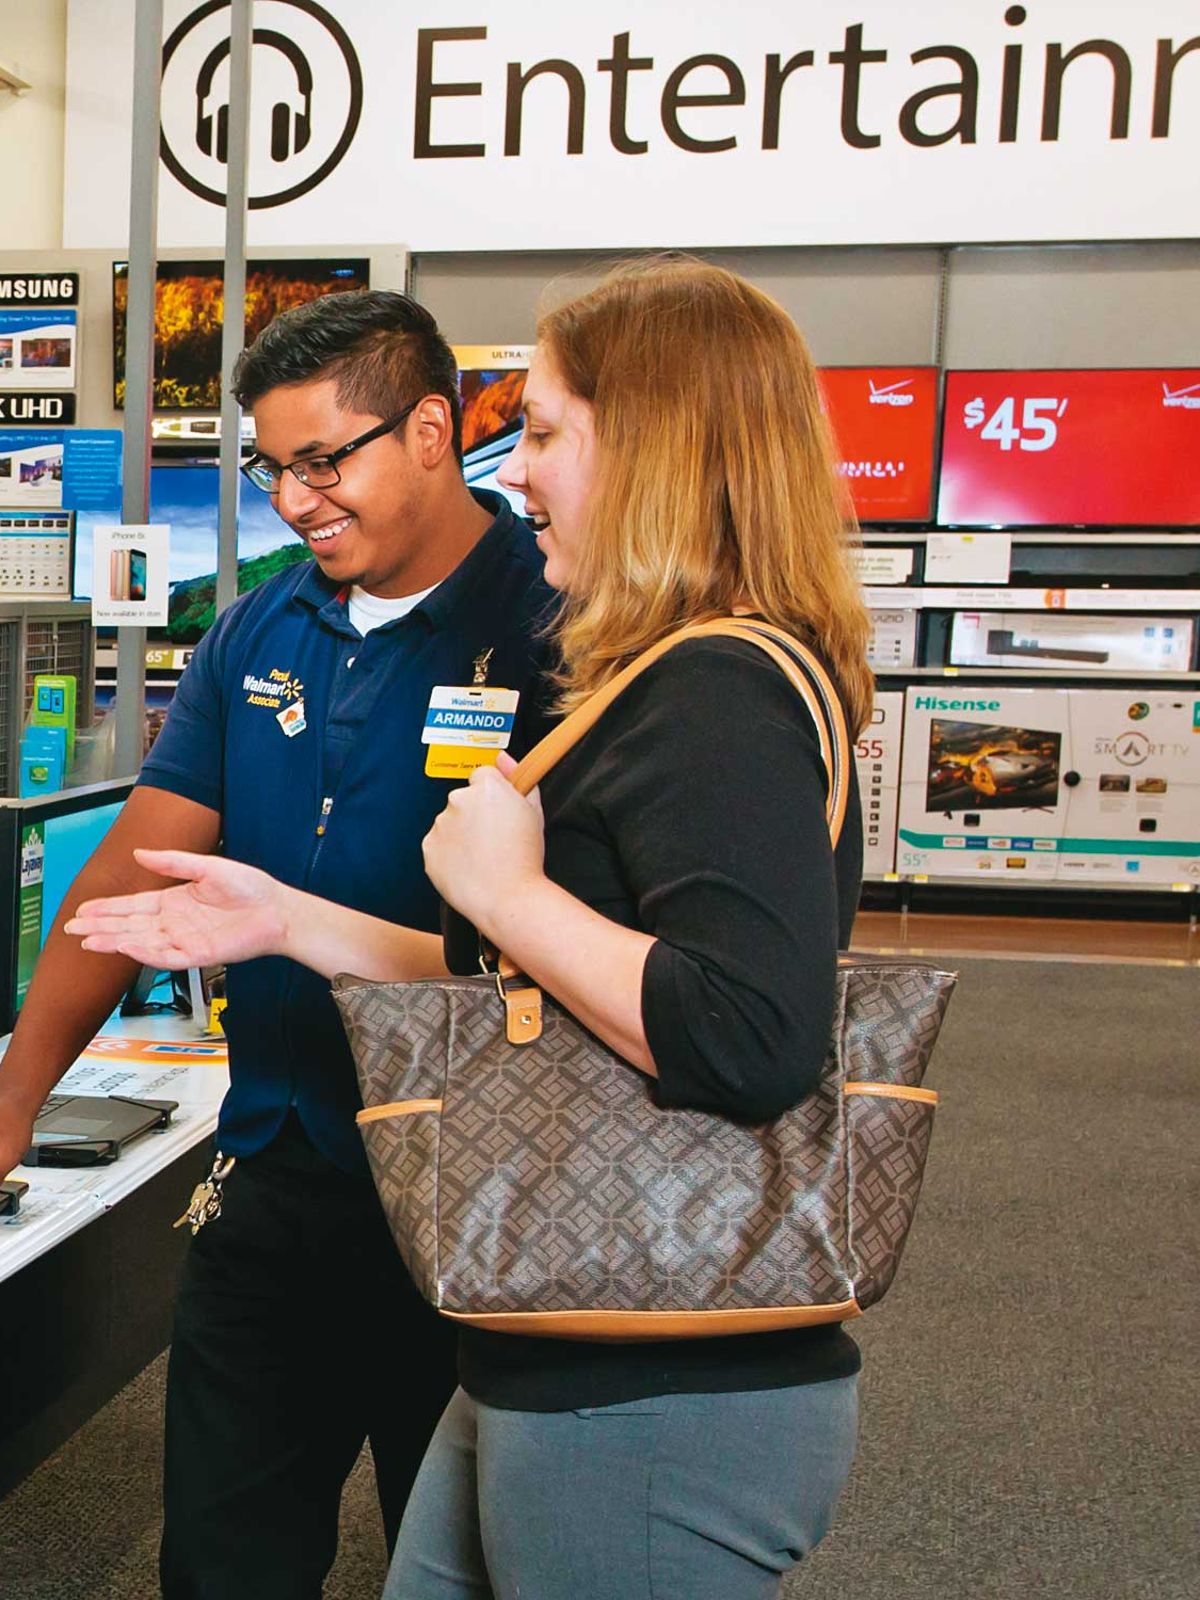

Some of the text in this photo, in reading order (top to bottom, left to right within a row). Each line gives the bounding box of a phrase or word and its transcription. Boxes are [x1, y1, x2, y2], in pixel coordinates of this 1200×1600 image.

[492, 351, 521, 359] ULTRA
[10, 398, 63, 418] UHD
[243, 674, 287, 697] Walmart
[451, 697, 484, 707] Walmart
[914, 696, 1001, 711] Hisense
[433, 712, 506, 728] ARMANDO
[856, 740, 884, 759] 55
